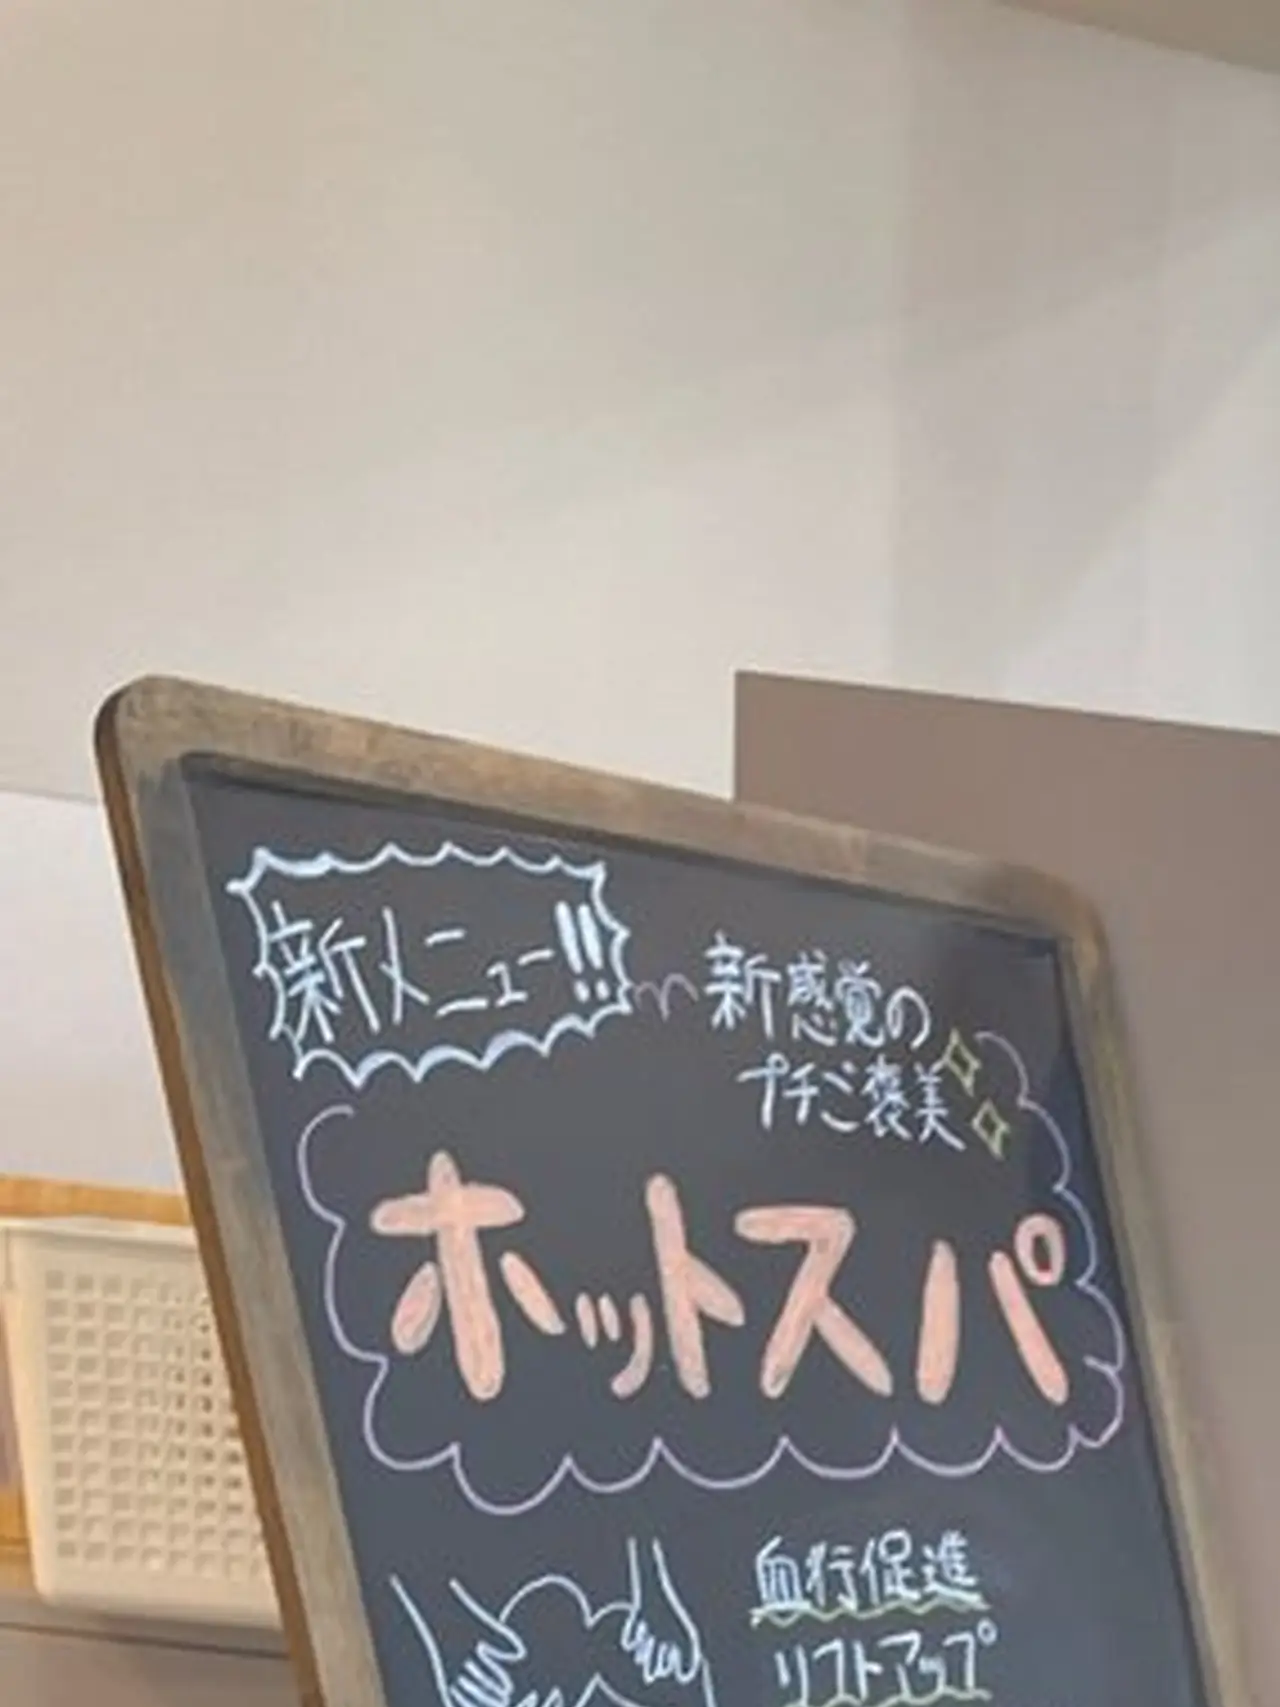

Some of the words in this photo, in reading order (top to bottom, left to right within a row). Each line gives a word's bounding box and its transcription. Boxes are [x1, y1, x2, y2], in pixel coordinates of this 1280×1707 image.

[703, 930, 932, 1051] 新感覚の
[736, 1052, 968, 1152] プチご褒美
[369, 1148, 1070, 1405] ホットスパ
[755, 1530, 984, 1613] 血行促進
